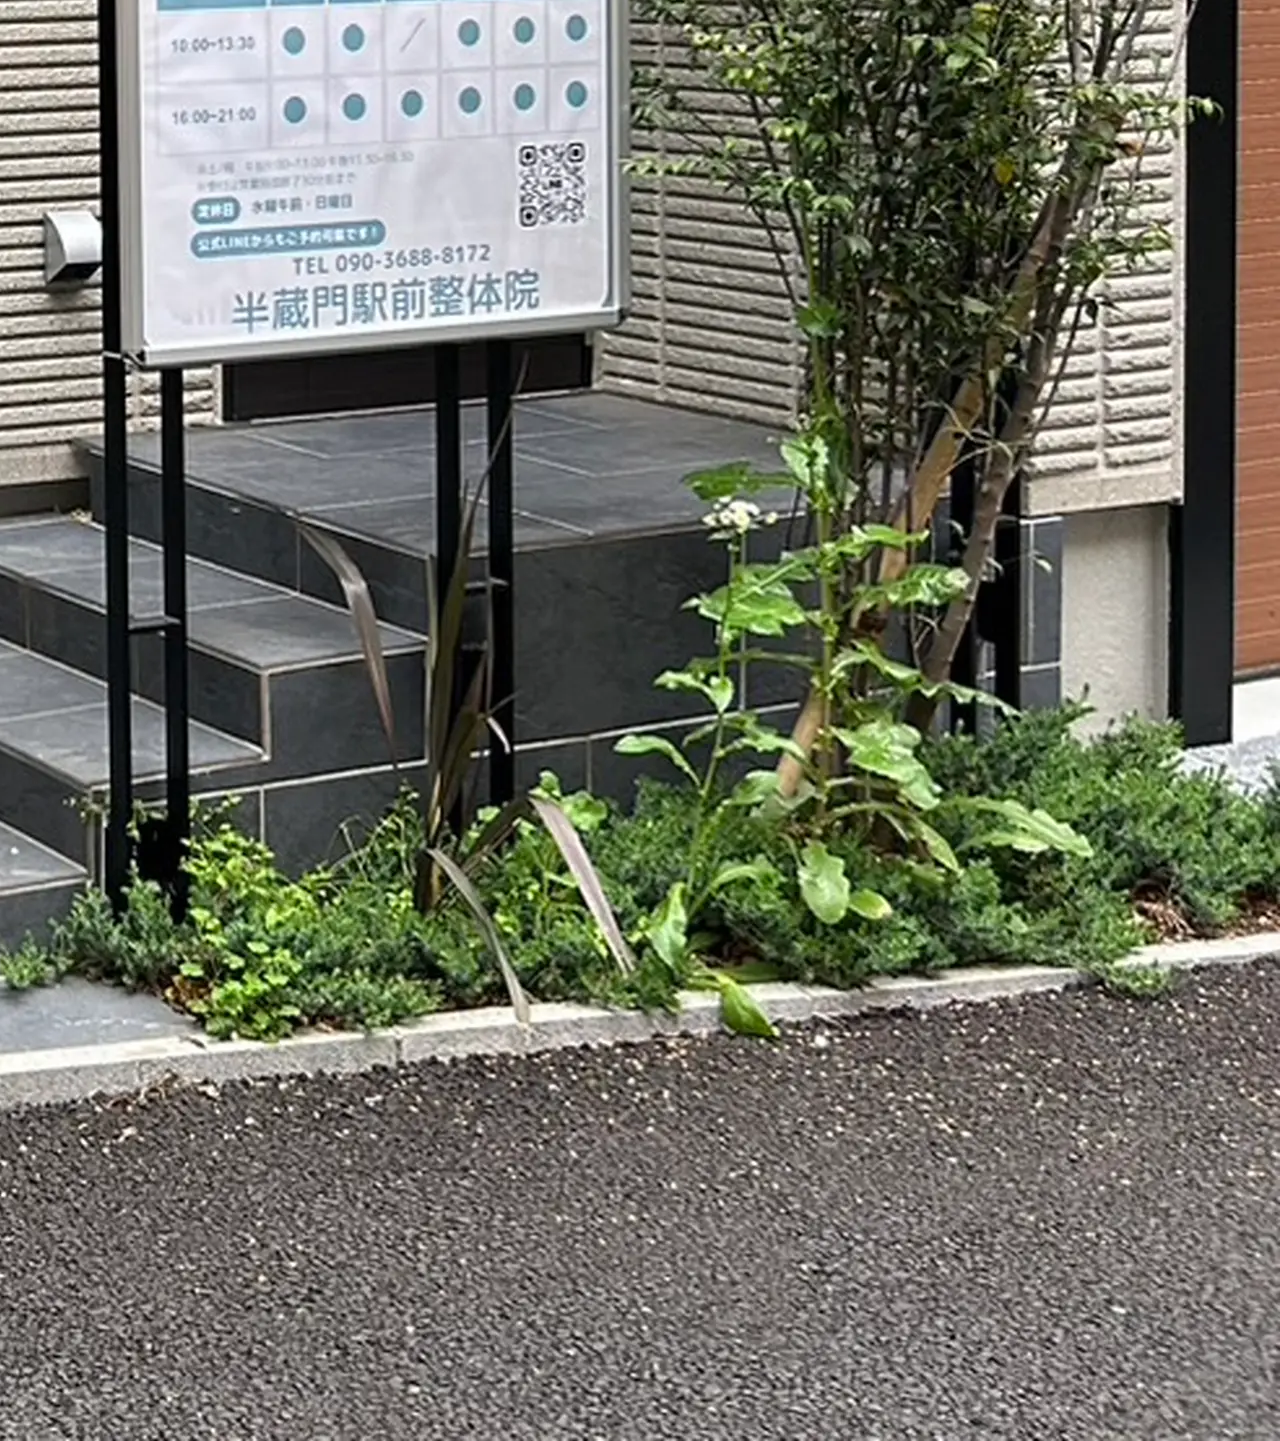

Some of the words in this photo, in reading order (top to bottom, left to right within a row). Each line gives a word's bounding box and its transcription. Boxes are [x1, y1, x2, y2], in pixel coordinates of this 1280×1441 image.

[293, 256, 329, 276] TEL
[336, 245, 490, 273] 090-3688-8172
[232, 268, 540, 334] 半蔵門駅前整体院
